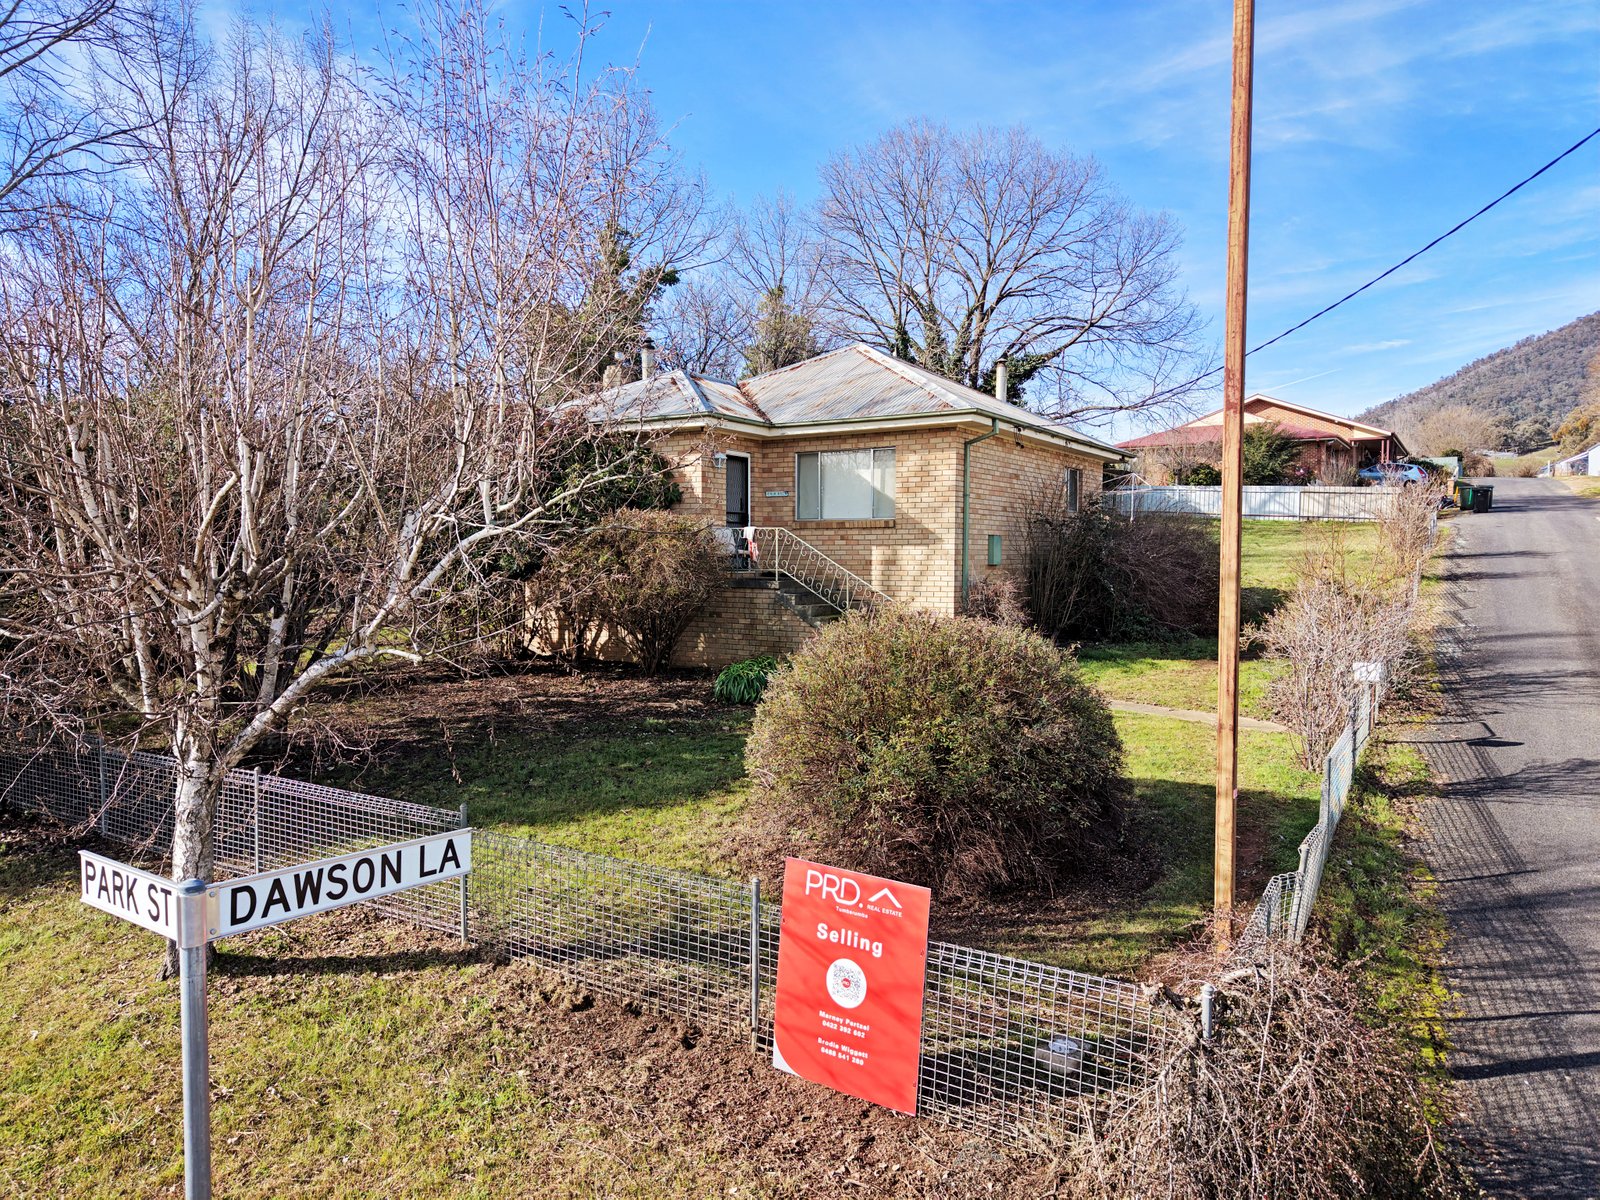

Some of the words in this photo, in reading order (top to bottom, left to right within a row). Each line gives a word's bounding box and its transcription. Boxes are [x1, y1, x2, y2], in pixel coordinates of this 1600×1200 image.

[85, 860, 139, 916] PARK
[147, 882, 172, 926] ST
[230, 850, 402, 926] DAWSON
[418, 838, 461, 877] LA
[867, 904, 881, 913] REAL
[882, 908, 902, 918] ESTATE
[816, 922, 883, 958] Selling
